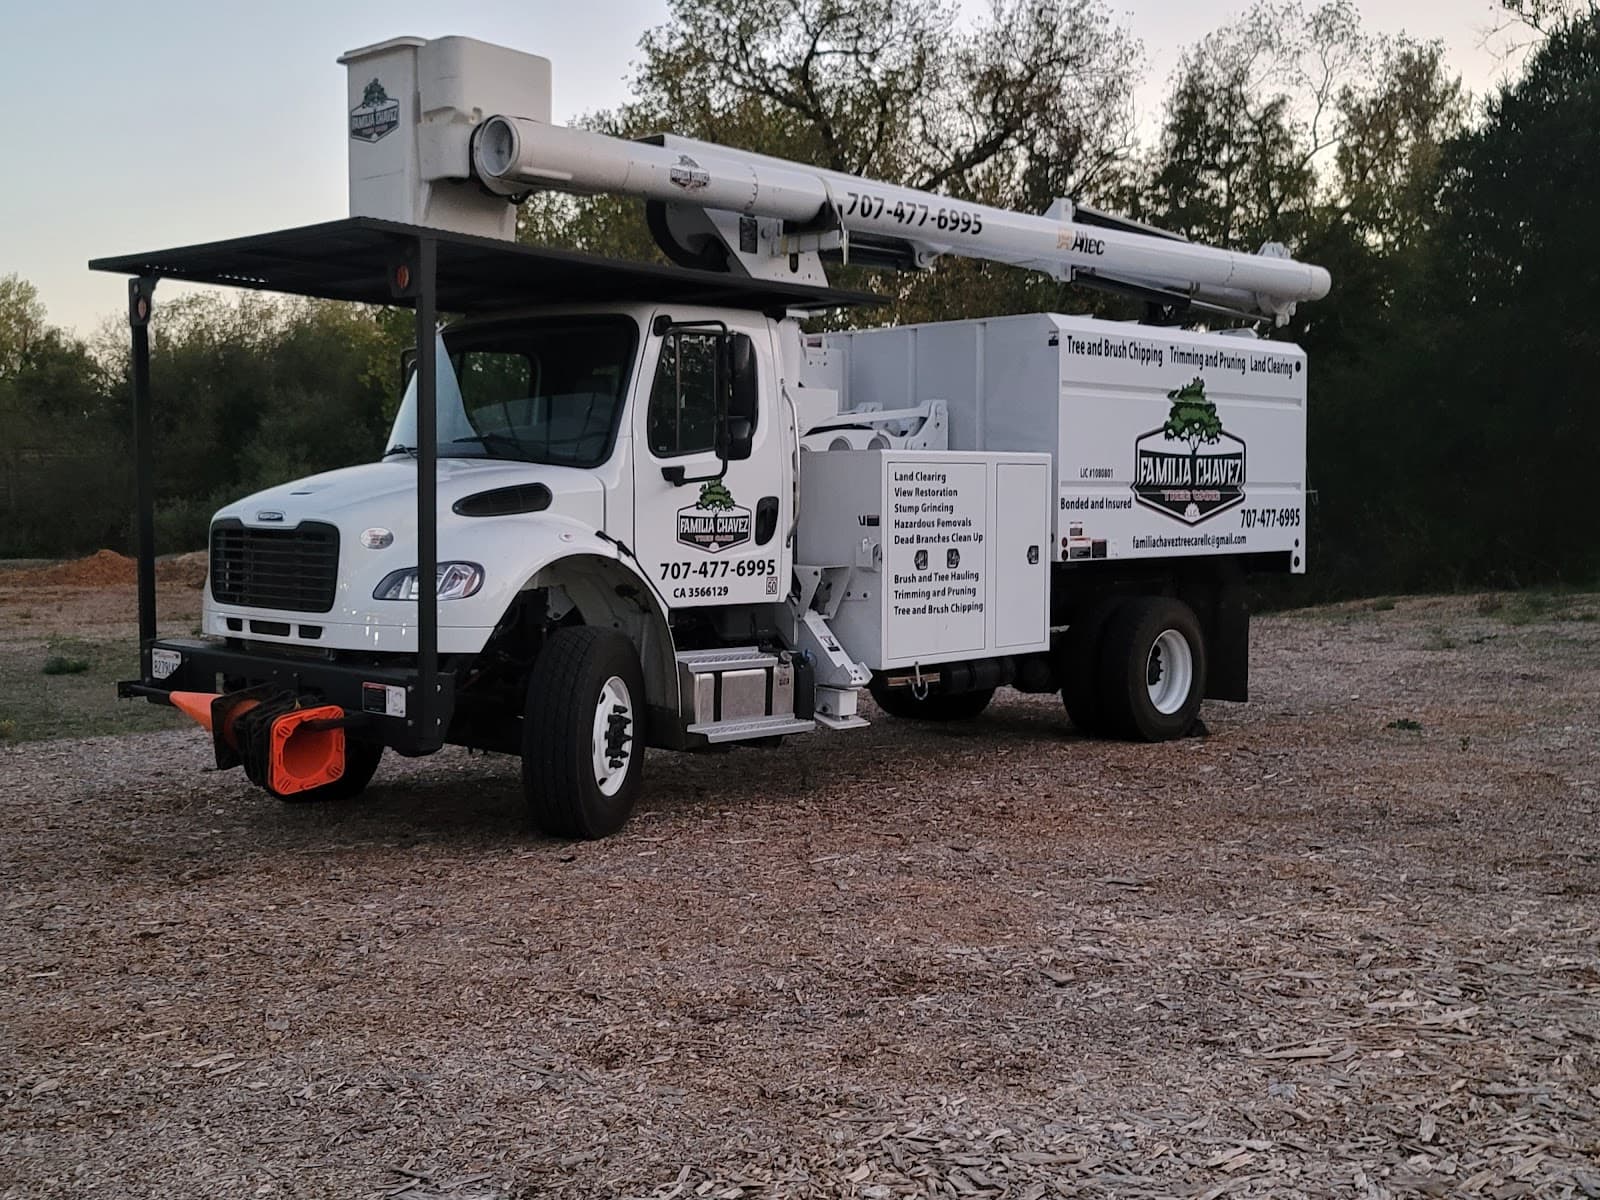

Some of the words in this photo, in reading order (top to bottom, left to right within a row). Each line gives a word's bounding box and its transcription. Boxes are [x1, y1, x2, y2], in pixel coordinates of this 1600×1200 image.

[847, 193, 982, 235] 707-477-6995
[1067, 335, 1085, 355] Tree
[1087, 338, 1102, 356] and
[1105, 339, 1127, 359] Brush
[1129, 342, 1163, 367] Chipping
[1170, 346, 1203, 371] Trimming
[1205, 351, 1218, 367] and
[1220, 352, 1245, 375] Pruning
[1251, 356, 1266, 372] Land
[1267, 357, 1292, 379] Clearing
[1140, 457, 1192, 484] FAMILIA
[1196, 458, 1242, 484] CHAVEZ
[895, 472, 913, 481] Land
[916, 472, 946, 484] Clearing
[895, 488, 913, 497] View
[915, 488, 957, 497] Restoration
[895, 504, 919, 515] Stump
[921, 503, 953, 514] Grinding
[1061, 497, 1089, 510] Bonded
[1091, 498, 1104, 509] and
[1106, 497, 1131, 509] Insured
[895, 518, 934, 528] Hazardous
[937, 517, 971, 527] Removals
[1241, 508, 1300, 528] 707-477-6995
[681, 518, 714, 533] FAMILIA
[717, 518, 748, 533] CHAVEZ
[895, 534, 914, 544] Dead
[916, 533, 949, 544] Branches
[952, 533, 971, 542] Clean
[973, 533, 983, 544] Up
[660, 559, 775, 580] 707-477-6995
[895, 573, 916, 584] Brush
[918, 572, 932, 582] and
[934, 572, 949, 581] Tree
[951, 570, 979, 582] Hauling
[674, 588, 686, 598] CA
[689, 586, 728, 597] 3566129
[894, 589, 930, 600] Trimming
[932, 587, 945, 597] and
[948, 586, 976, 597] Pruning
[894, 606, 910, 615] Tree
[912, 605, 926, 614] and
[928, 604, 948, 614] Brush
[951, 602, 983, 614] Chipping
